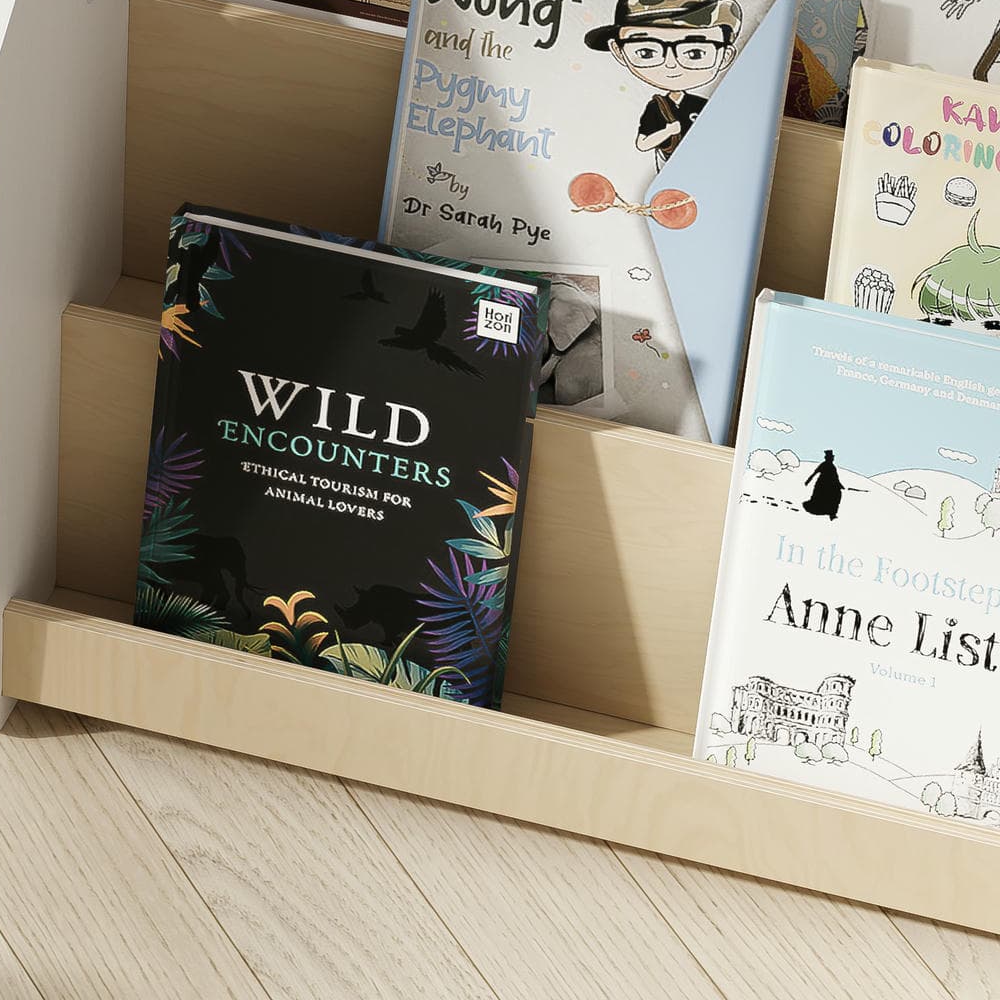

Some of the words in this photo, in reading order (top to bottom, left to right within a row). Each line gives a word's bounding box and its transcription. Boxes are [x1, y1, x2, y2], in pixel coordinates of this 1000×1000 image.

[425, 28, 474, 61] and
[480, 29, 513, 61] the
[413, 58, 532, 123] Pygmy
[406, 100, 556, 160] Elephant
[863, 120, 1000, 173] COLORIN
[449, 178, 469, 199] by
[402, 197, 432, 217] Dr
[439, 204, 503, 234] Sarah
[511, 217, 551, 245] Pye
[484, 319, 512, 334] zon
[485, 307, 512, 324] Hori
[812, 346, 852, 363] Travels
[855, 355, 868, 367] of
[869, 359, 876, 368] a
[878, 361, 941, 384] remarkable
[943, 375, 986, 394] English
[880, 375, 931, 397] Germany
[933, 388, 955, 400] and
[237, 369, 430, 448] WILD
[217, 419, 453, 489] ENCOUNTERS
[240, 461, 307, 487] ETHICAL
[310, 475, 379, 502] TOURISM
[383, 491, 412, 509] FOR
[264, 486, 325, 509] ANIMAL
[328, 499, 385, 522] LOVERS
[775, 533, 805, 566] In
[816, 543, 864, 578] the
[763, 582, 893, 647] Anne
[909, 610, 1000, 672] List
[869, 662, 925, 686] Volume
